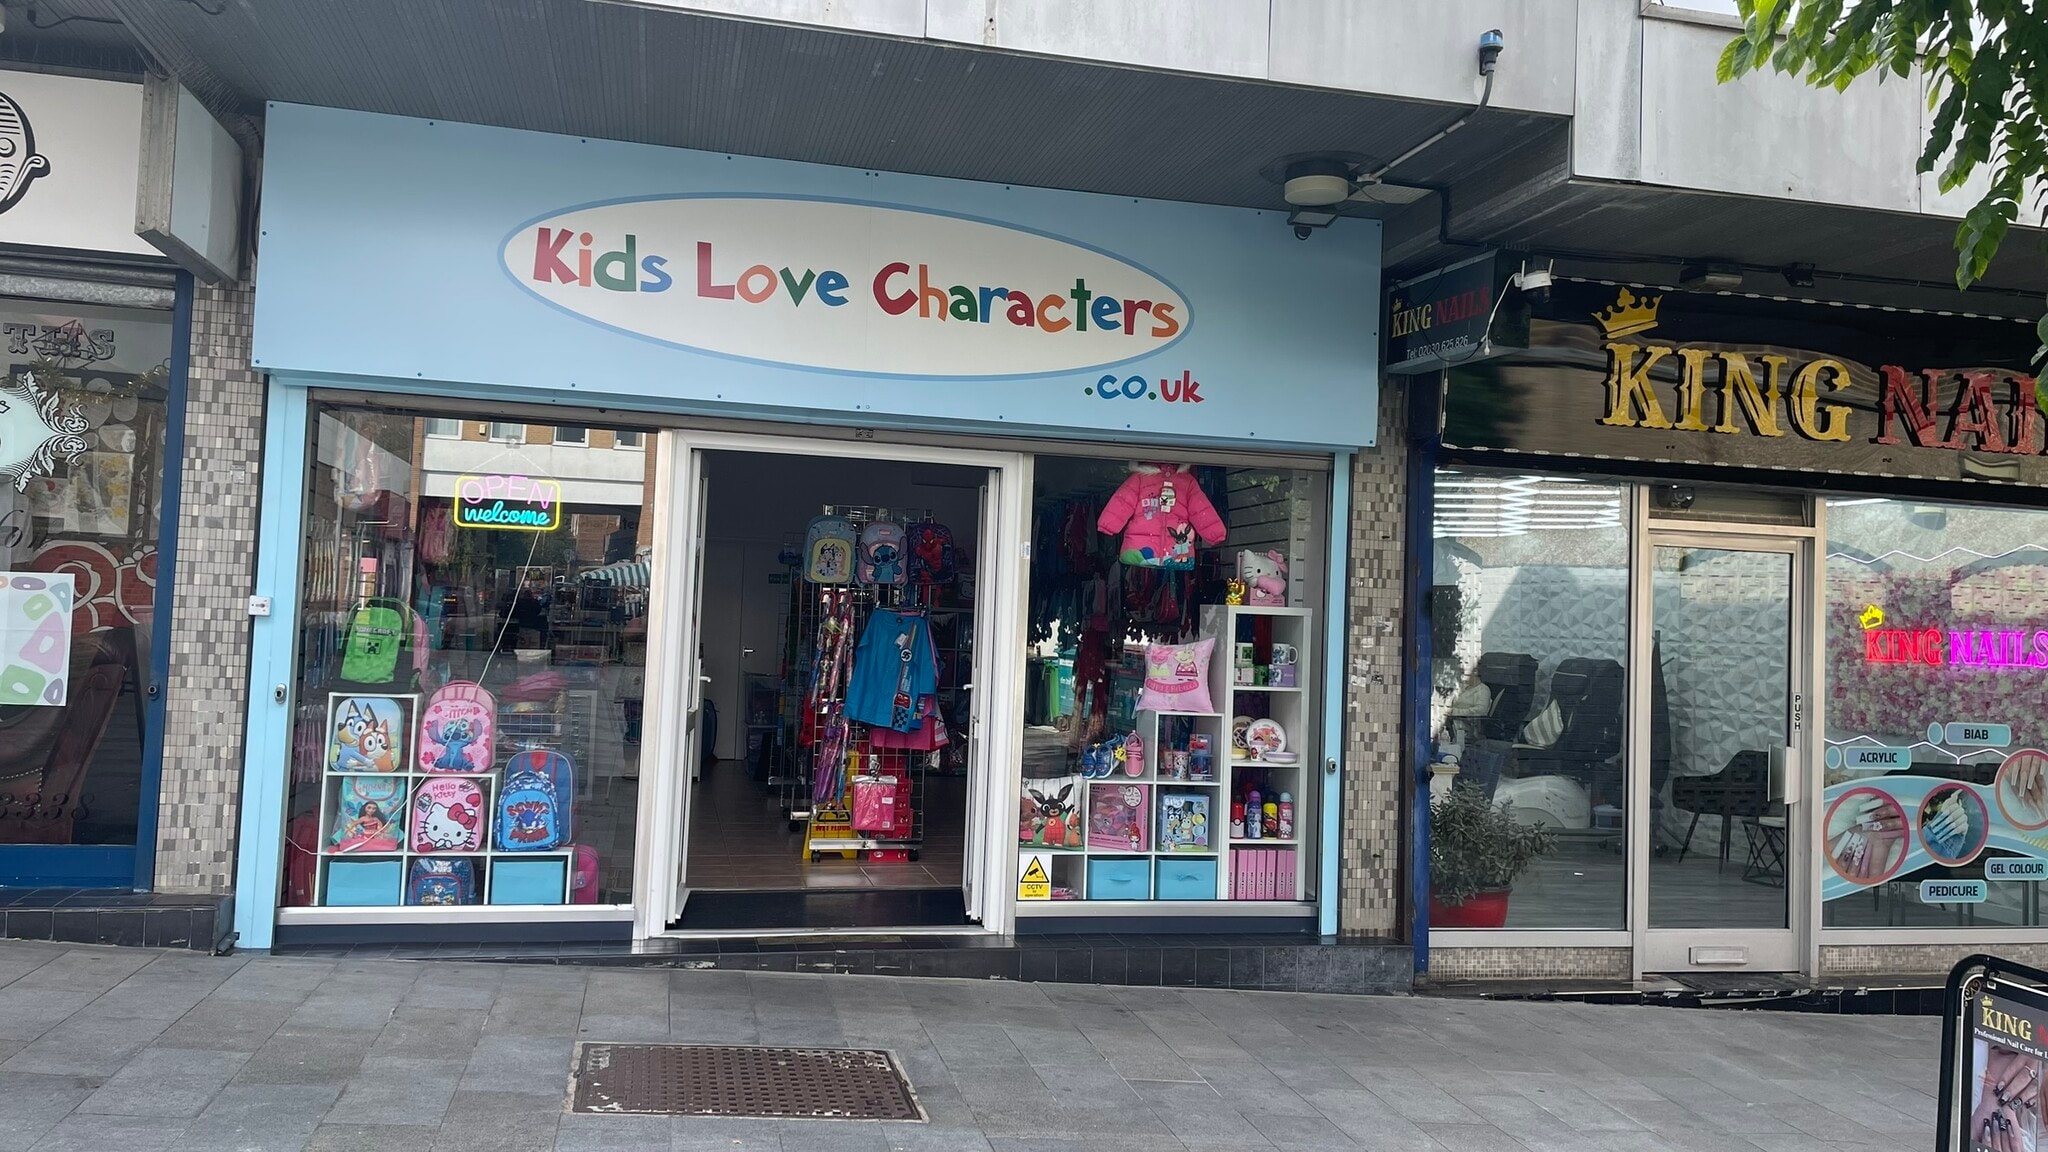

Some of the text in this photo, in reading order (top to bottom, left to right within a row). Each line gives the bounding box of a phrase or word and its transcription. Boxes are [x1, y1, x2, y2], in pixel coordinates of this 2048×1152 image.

[533, 227, 1180, 338] Kids Love Characters
[1391, 286, 1490, 338] KING NAILS
[1083, 370, 1204, 403] .co.uk
[1600, 341, 1852, 442] KING
[462, 475, 554, 510] OPEN
[464, 500, 550, 526] welcome
[1865, 628, 2048, 669] KING NAILS
[1963, 728, 1989, 740] BIAB
[1859, 752, 1898, 763] ACRYLIC
[432, 783, 456, 792] Hello
[1990, 863, 2044, 874] GEL COLOUR
[1928, 885, 1978, 897] PEDICURE
[1981, 1006, 2032, 1041] KING
[1974, 1027, 2006, 1044] Professional
[2006, 1038, 2019, 1049] Nail
[2020, 1043, 2034, 1055] Care
